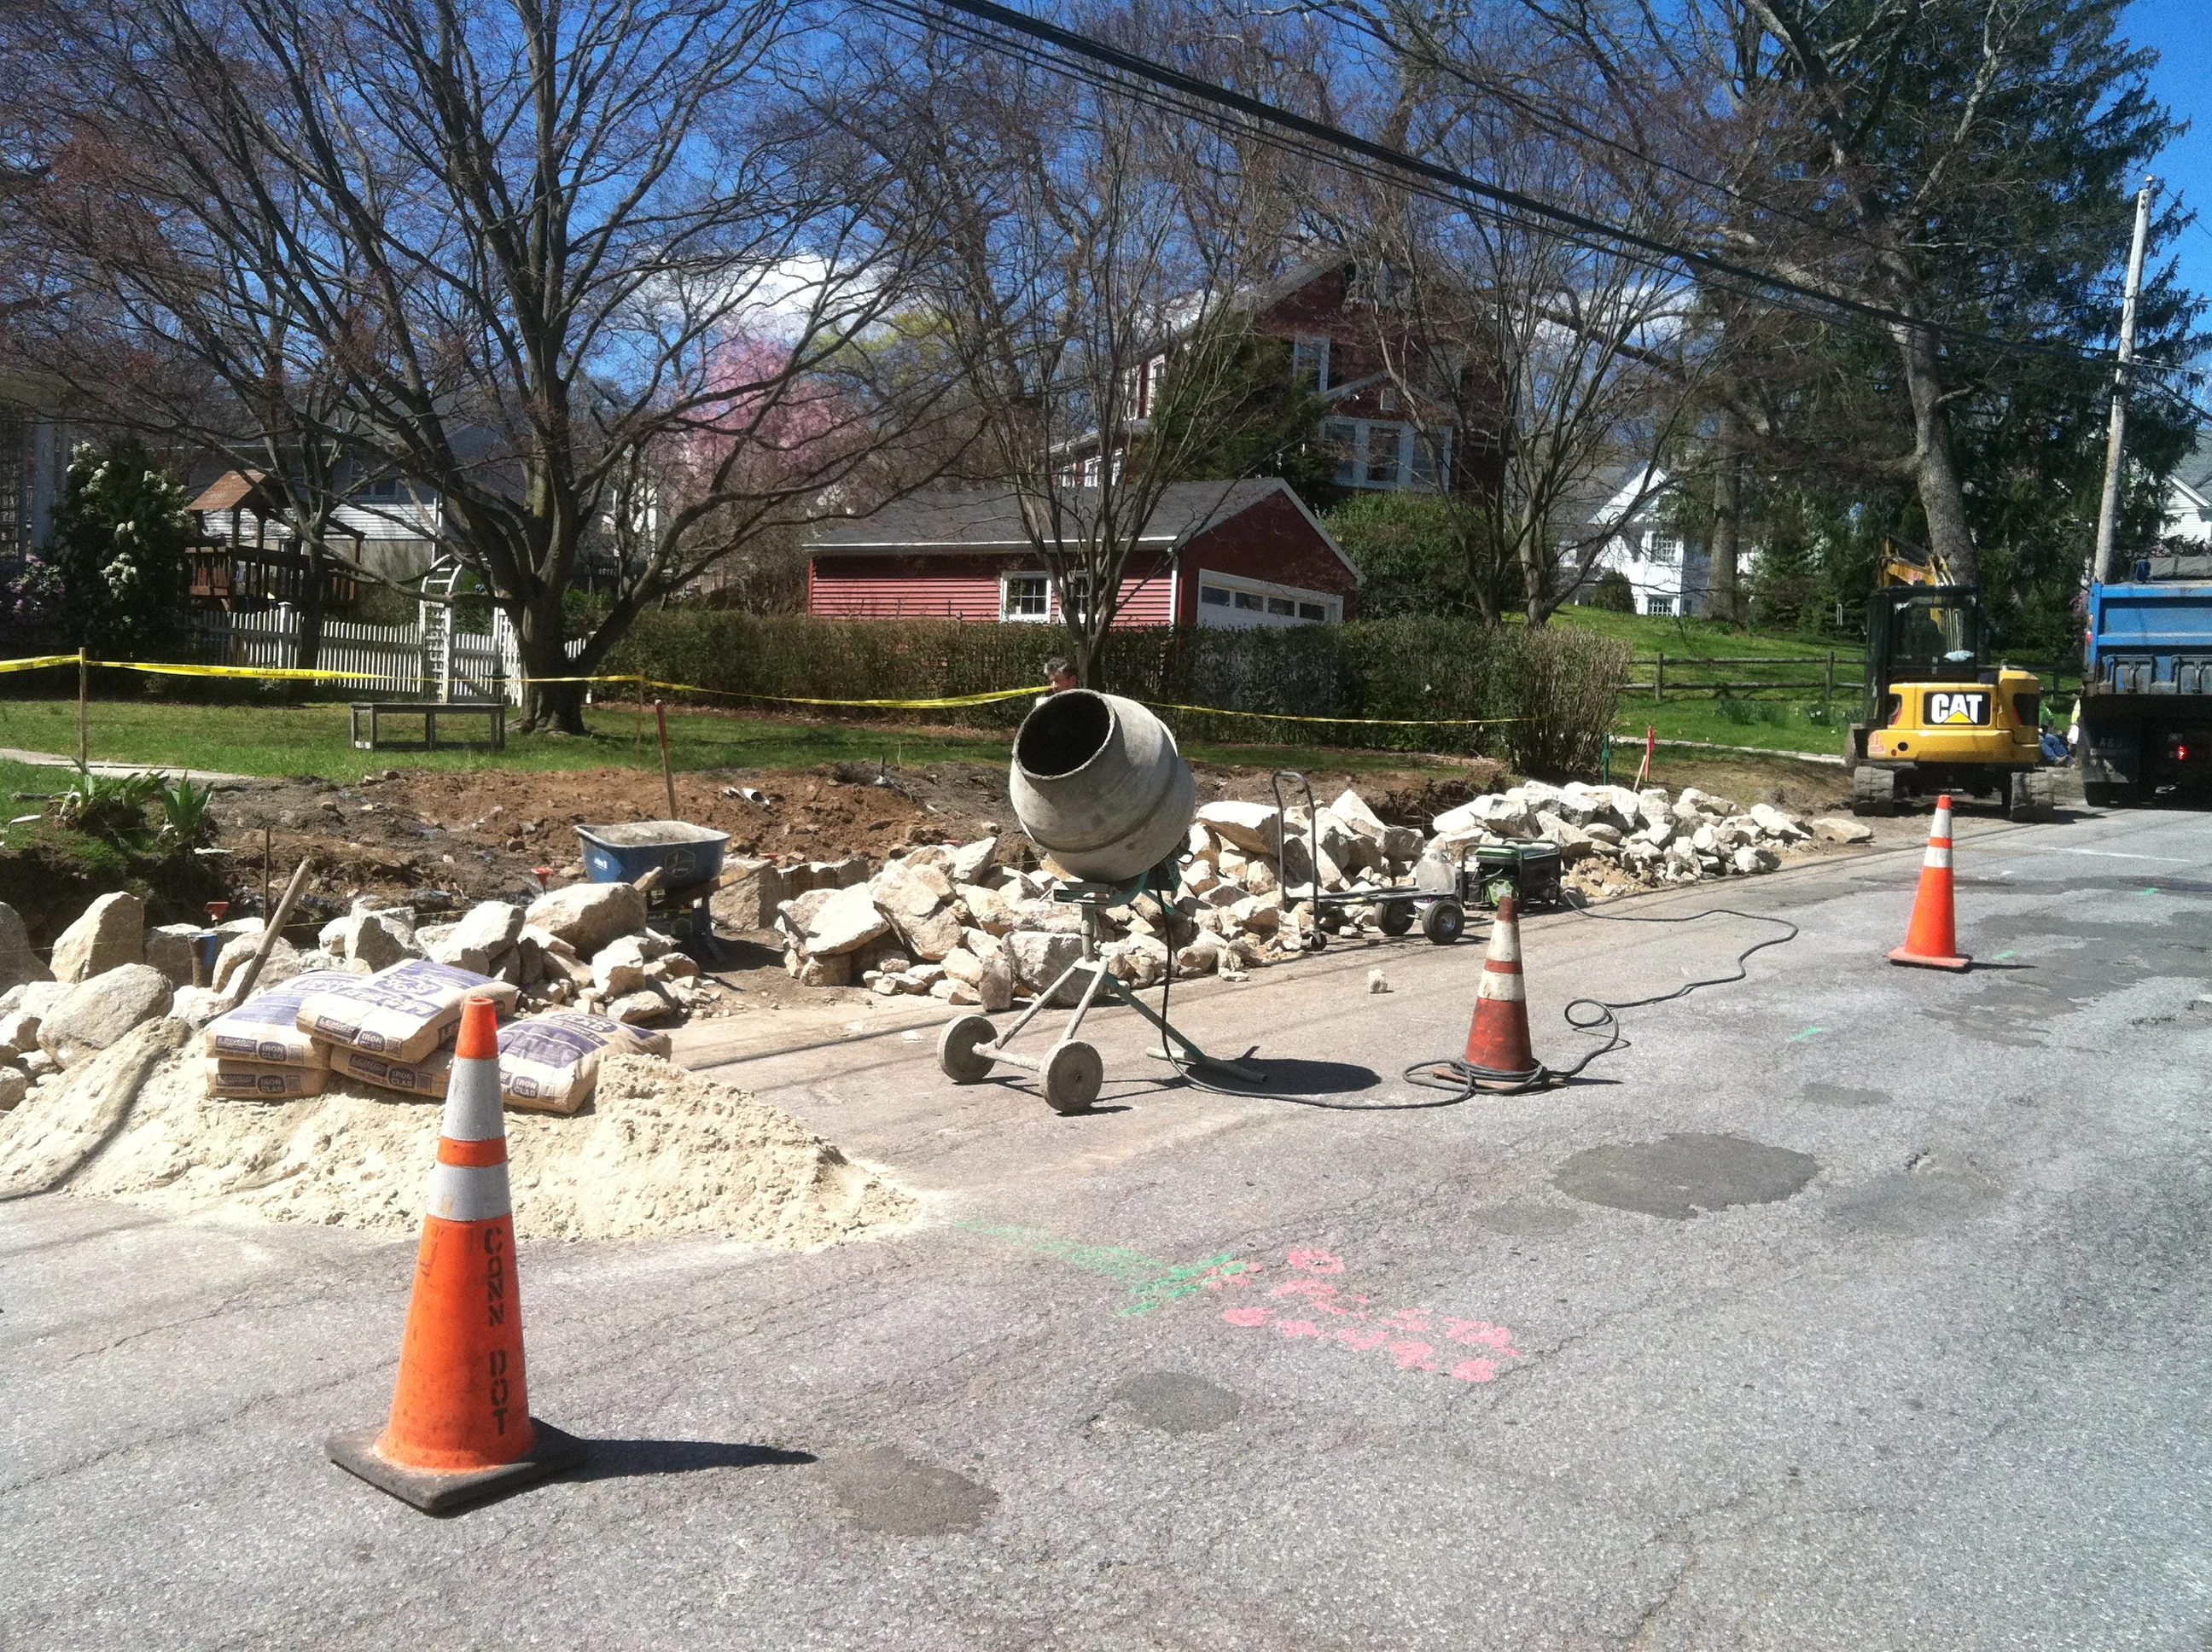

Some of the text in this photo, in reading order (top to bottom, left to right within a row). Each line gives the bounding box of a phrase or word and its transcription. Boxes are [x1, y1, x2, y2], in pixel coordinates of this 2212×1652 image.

[1931, 694, 1982, 724] CAT
[362, 1032, 383, 1044] IRON
[262, 1044, 284, 1053] IRON
[393, 1070, 413, 1080] IRON
[391, 1078, 413, 1087] CLAD
[515, 1078, 538, 1090] IRON
[513, 1085, 536, 1096] CLAD
[485, 1226, 509, 1435] CONN DOT
